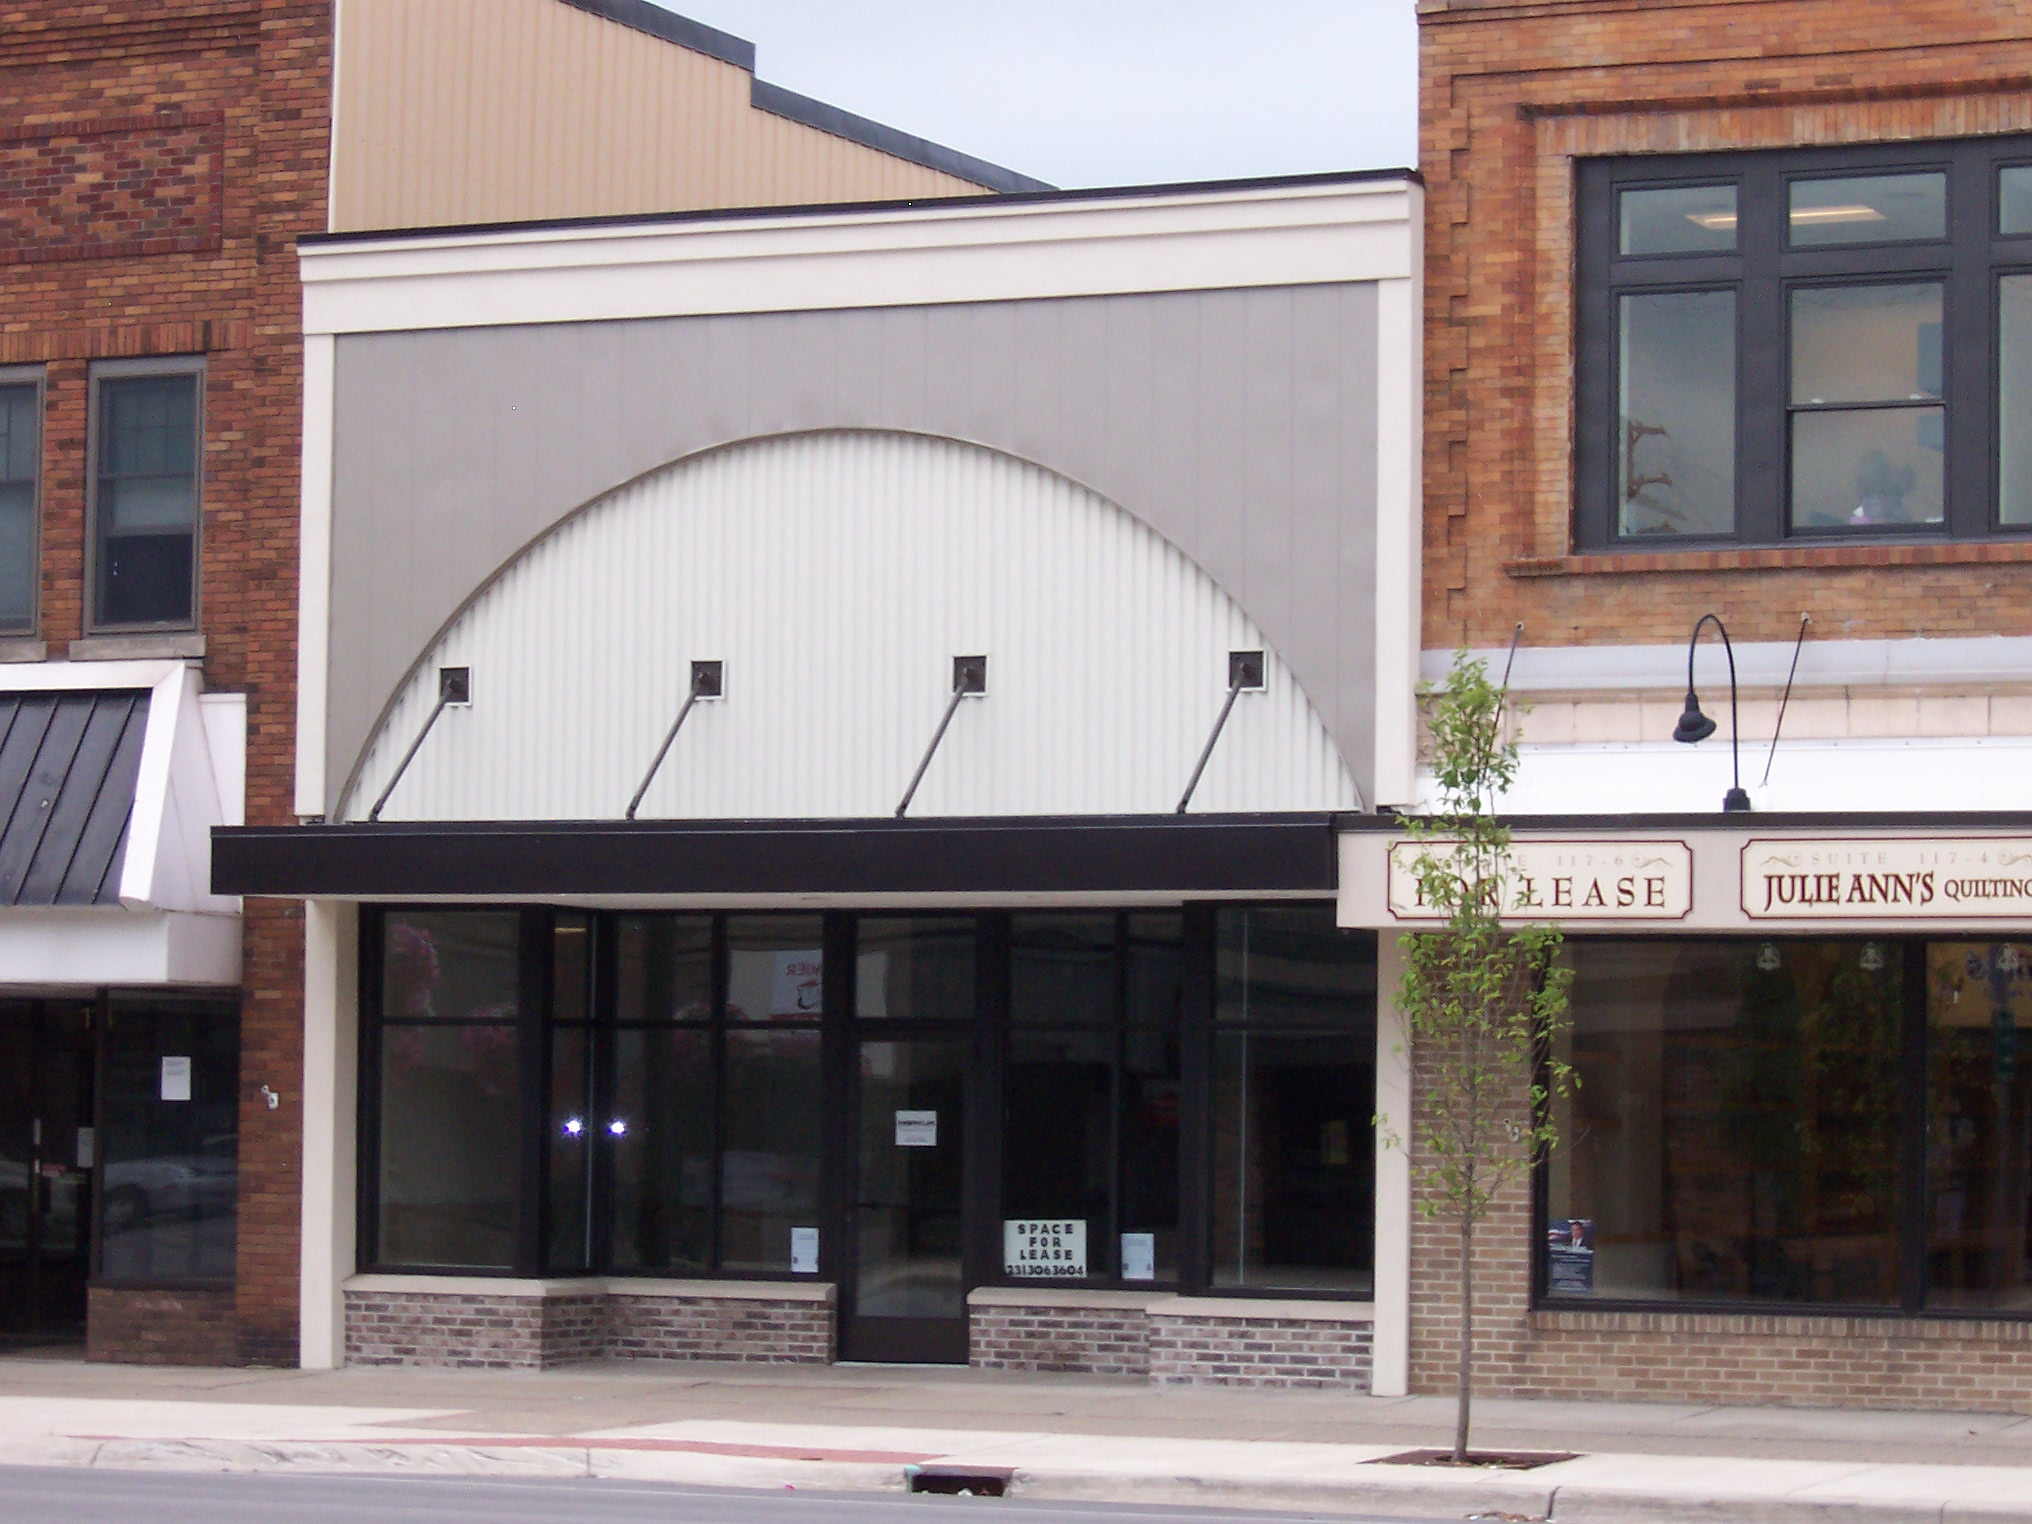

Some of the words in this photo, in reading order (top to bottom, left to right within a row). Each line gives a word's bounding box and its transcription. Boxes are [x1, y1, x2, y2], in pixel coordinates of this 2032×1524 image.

[1557, 854, 1624, 867] 117-6
[1811, 852, 1888, 866] SUITE
[1919, 851, 1989, 865] 117-4
[1522, 875, 1666, 908] LEASE
[1763, 872, 1841, 912] JULIE
[1846, 870, 1935, 906] ANN'S
[1017, 1223, 1073, 1235] SPACE
[1029, 1236, 1061, 1248] FOR
[1019, 1249, 1073, 1261] LEASE
